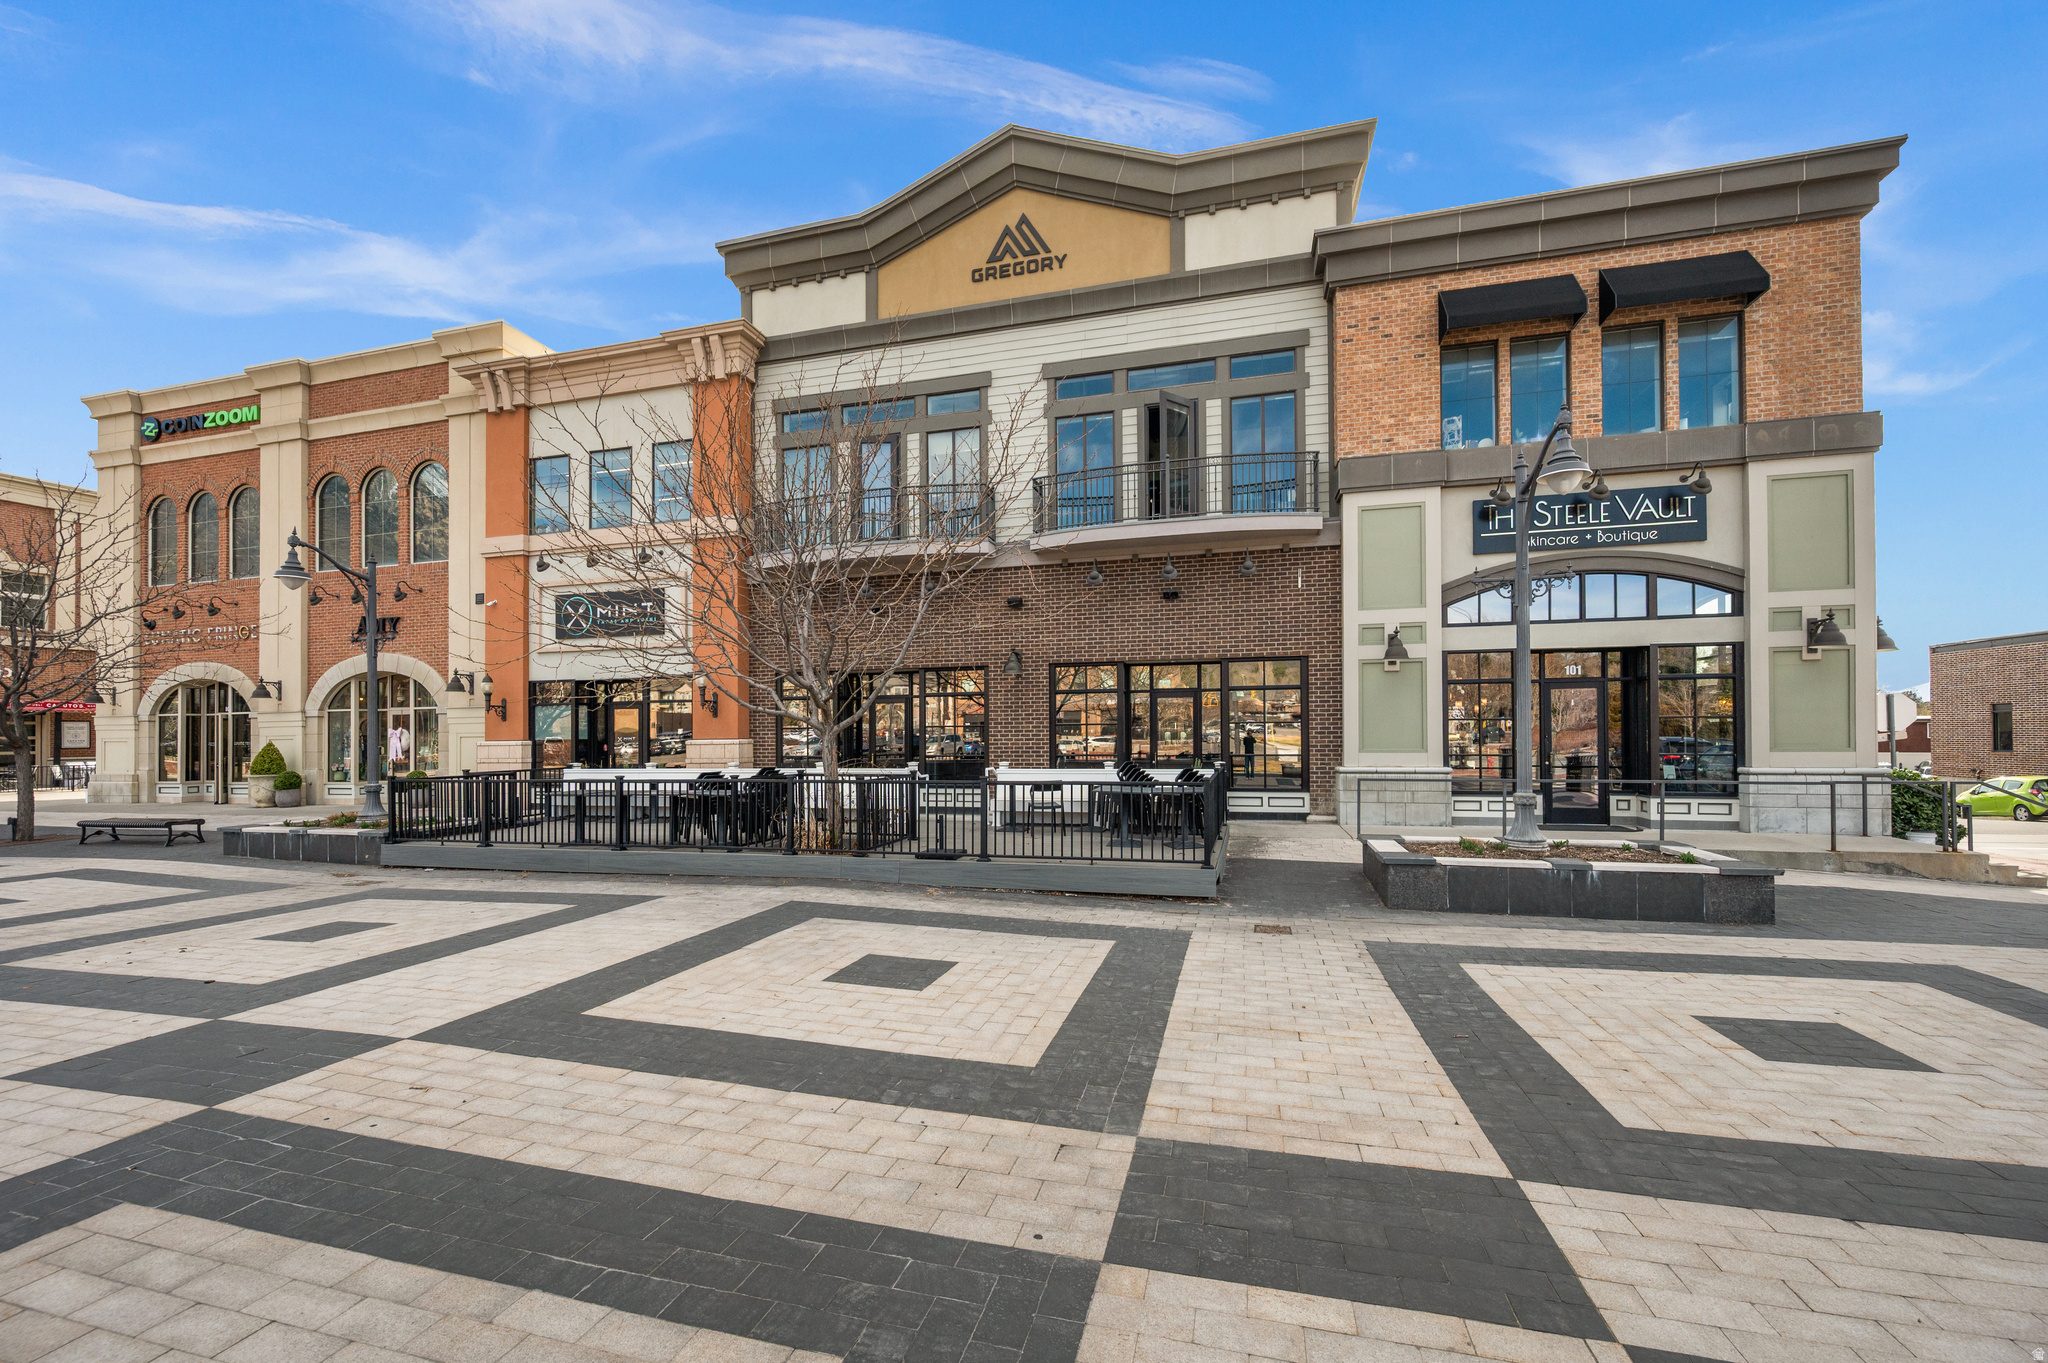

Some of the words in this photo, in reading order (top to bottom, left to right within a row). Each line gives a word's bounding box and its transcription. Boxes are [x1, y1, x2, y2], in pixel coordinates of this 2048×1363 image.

[971, 253, 1068, 283] GREGORY
[161, 405, 260, 434] COINZOOM
[1484, 504, 1515, 530] TH
[1533, 500, 1611, 527] STEELE
[1614, 493, 1697, 521] VAULT
[1597, 529, 1659, 545] Boutique
[596, 602, 656, 618] MINT
[1564, 665, 1582, 676] 101
